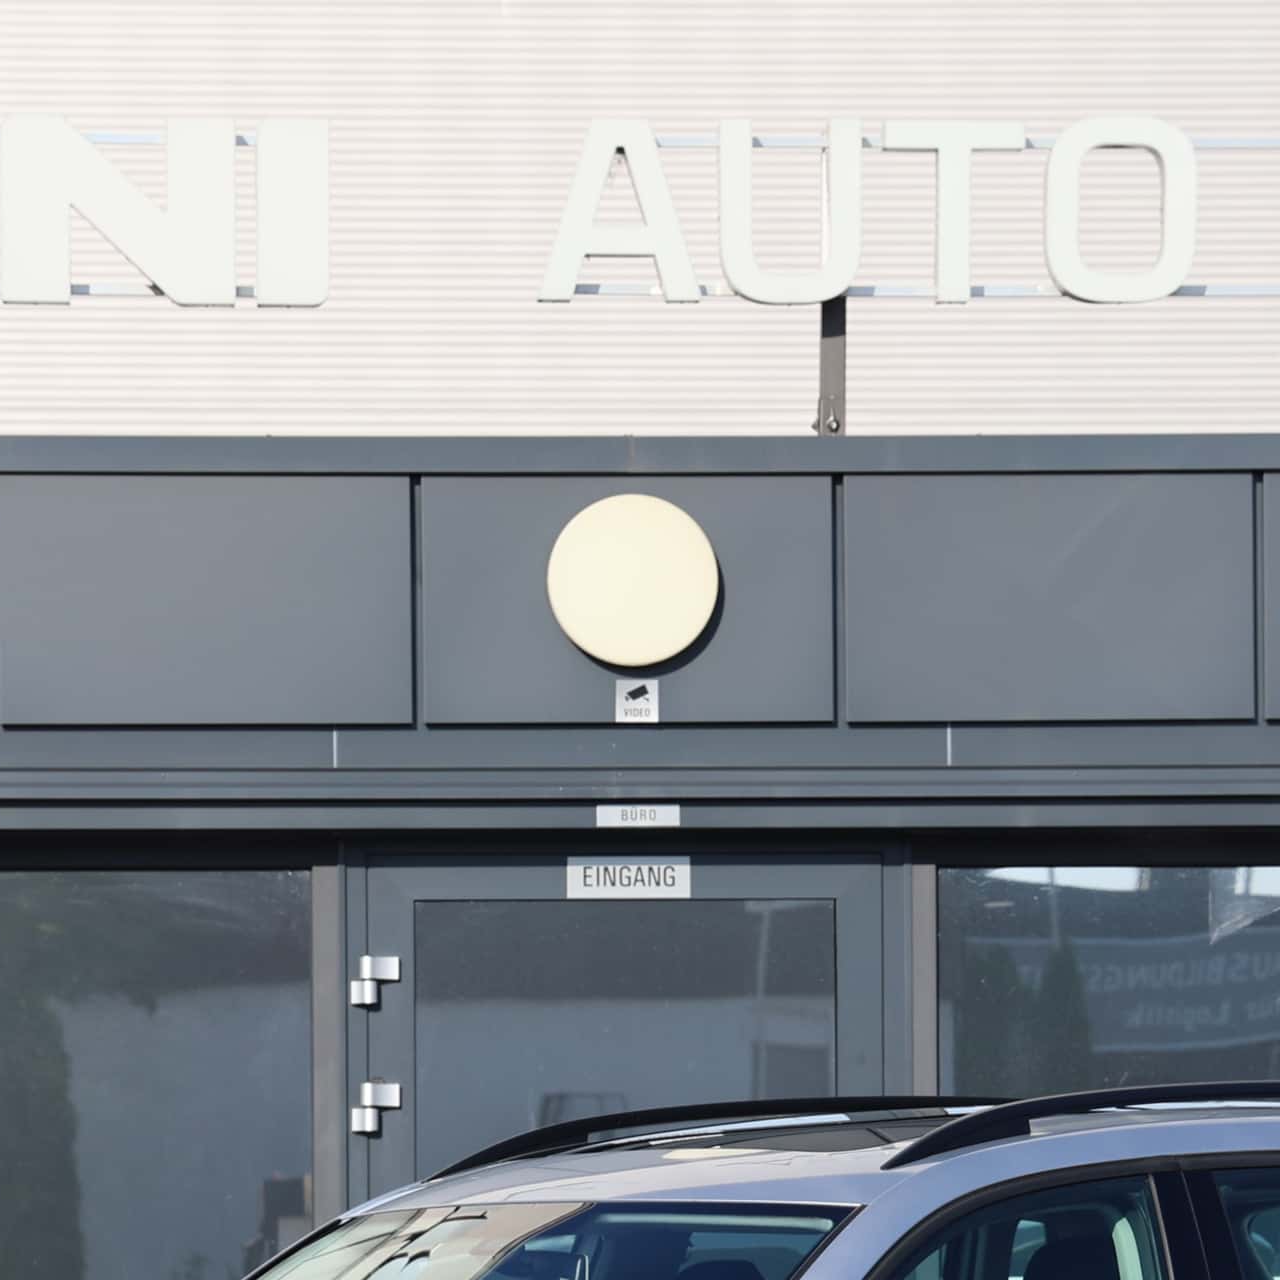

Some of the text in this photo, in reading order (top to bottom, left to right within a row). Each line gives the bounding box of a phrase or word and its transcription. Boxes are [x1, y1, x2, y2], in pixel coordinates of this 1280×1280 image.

[537, 114, 1197, 306] AUTO
[623, 707, 652, 718] VIDEO
[583, 865, 676, 888] EINGANG
